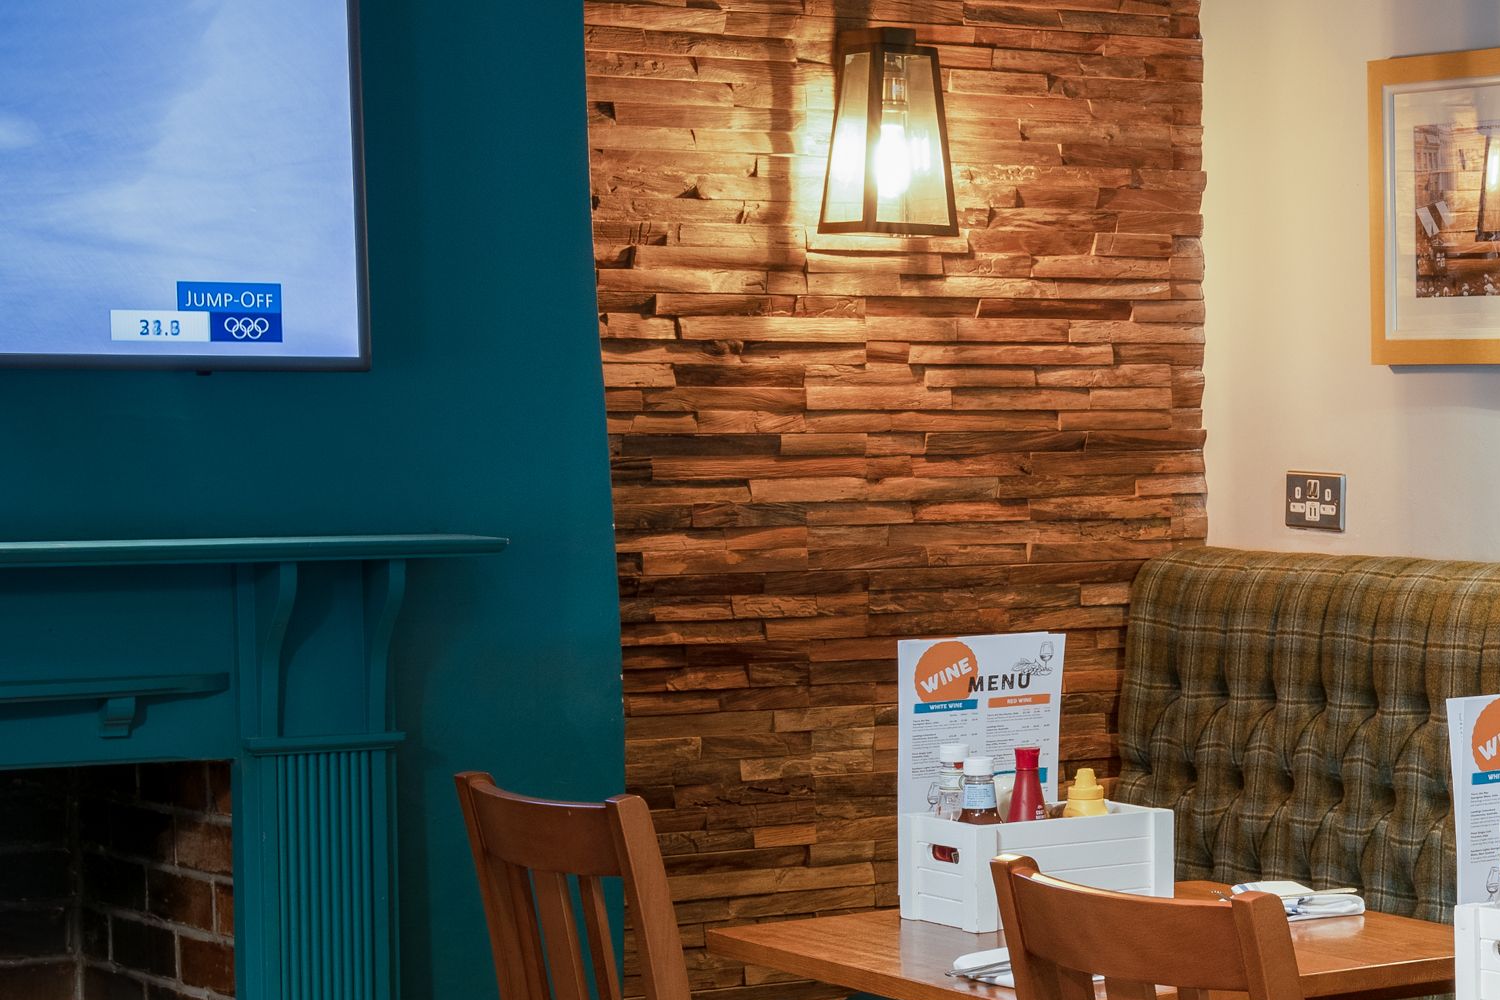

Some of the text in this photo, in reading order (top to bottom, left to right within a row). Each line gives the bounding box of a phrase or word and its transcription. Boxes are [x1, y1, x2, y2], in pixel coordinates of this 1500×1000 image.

[185, 290, 273, 308] JUMP-OFF
[920, 657, 973, 694] WINE
[967, 672, 1031, 693] MENU
